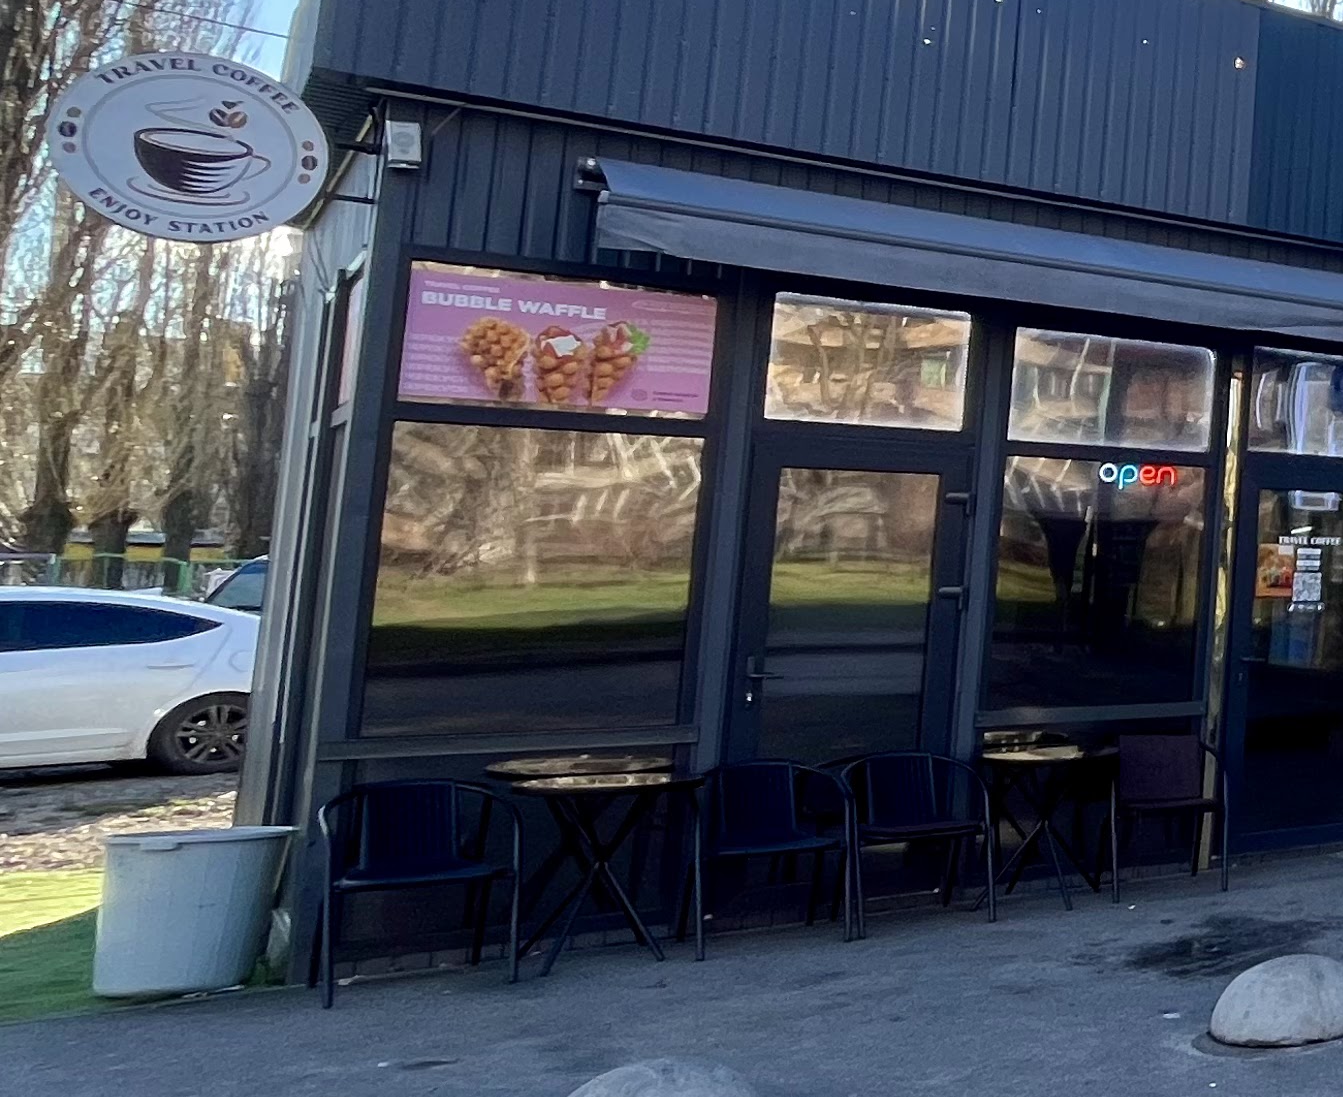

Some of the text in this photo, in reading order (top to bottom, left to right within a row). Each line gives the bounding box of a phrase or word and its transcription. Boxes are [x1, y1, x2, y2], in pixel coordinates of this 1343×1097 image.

[95, 57, 302, 115] TRAVEL COFFEE
[88, 187, 271, 235] ENJOY STATION
[421, 291, 512, 312] BUBBLE
[517, 300, 607, 320] WAFFLE
[1099, 463, 1174, 490] open
